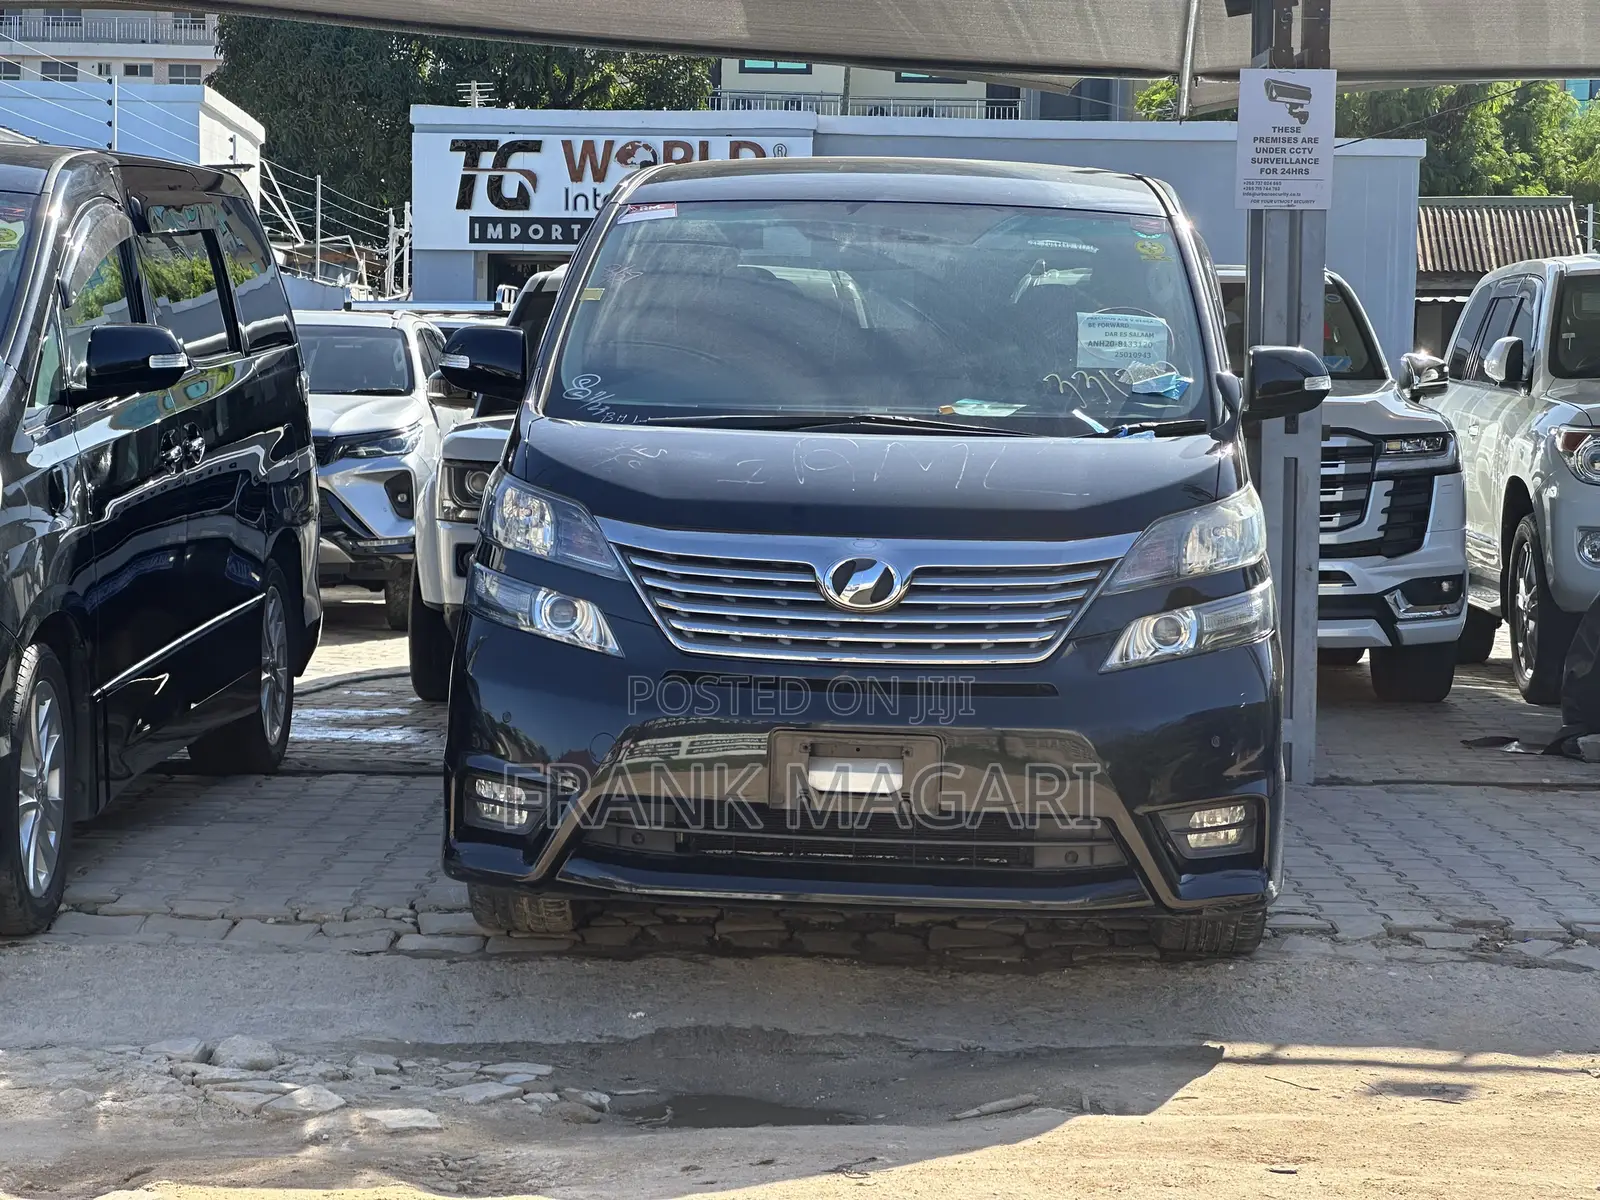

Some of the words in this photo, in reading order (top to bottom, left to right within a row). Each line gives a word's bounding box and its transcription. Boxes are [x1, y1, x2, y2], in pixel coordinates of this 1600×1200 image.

[1272, 126, 1302, 134] THESE
[1253, 136, 1299, 144] PREMISES
[1250, 157, 1320, 165] SURVEILLANCE
[474, 224, 581, 240] IMPORT
